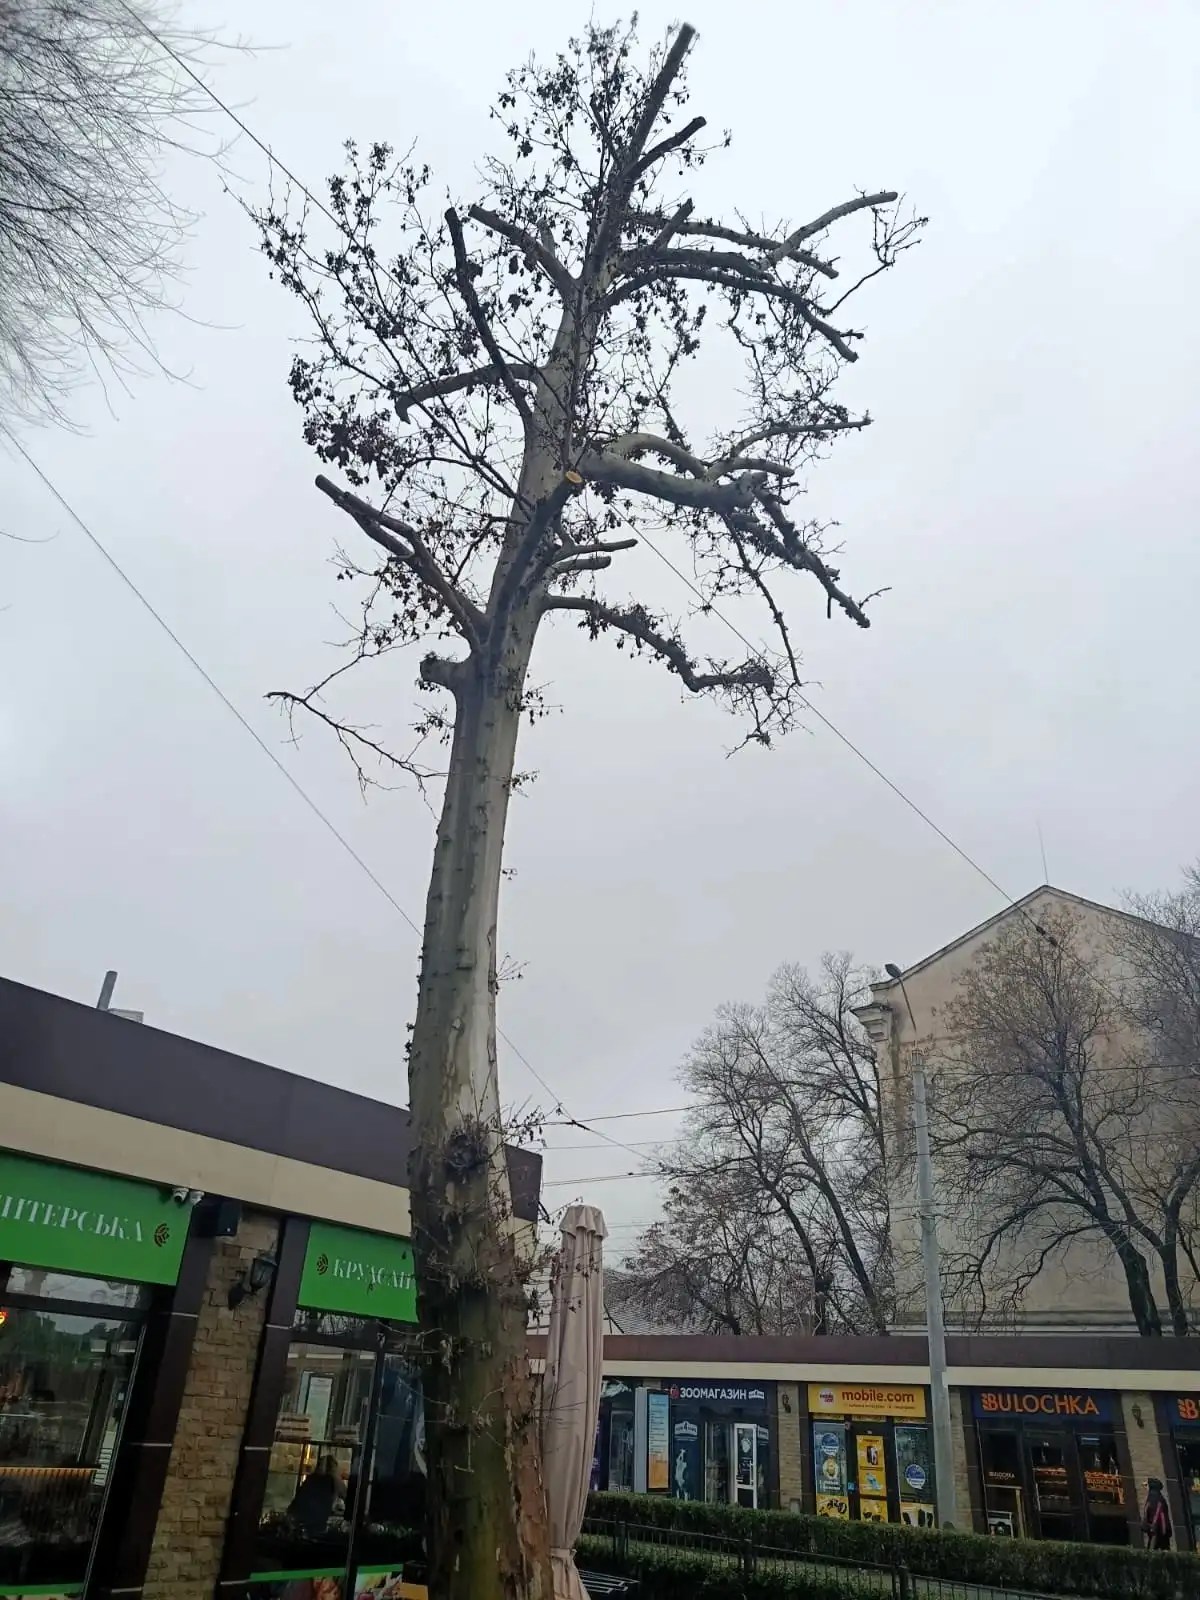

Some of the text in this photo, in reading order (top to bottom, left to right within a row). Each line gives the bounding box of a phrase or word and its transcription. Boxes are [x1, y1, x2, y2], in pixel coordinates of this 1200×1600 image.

[0, 1194, 143, 1242] ИТЕРСЬКА
[680, 1386, 747, 1400] ЗООМАГАЗИН
[842, 1388, 915, 1403] mobile.com
[981, 1392, 1100, 1415] BULOCHKA
[1177, 1398, 1200, 1420] B
